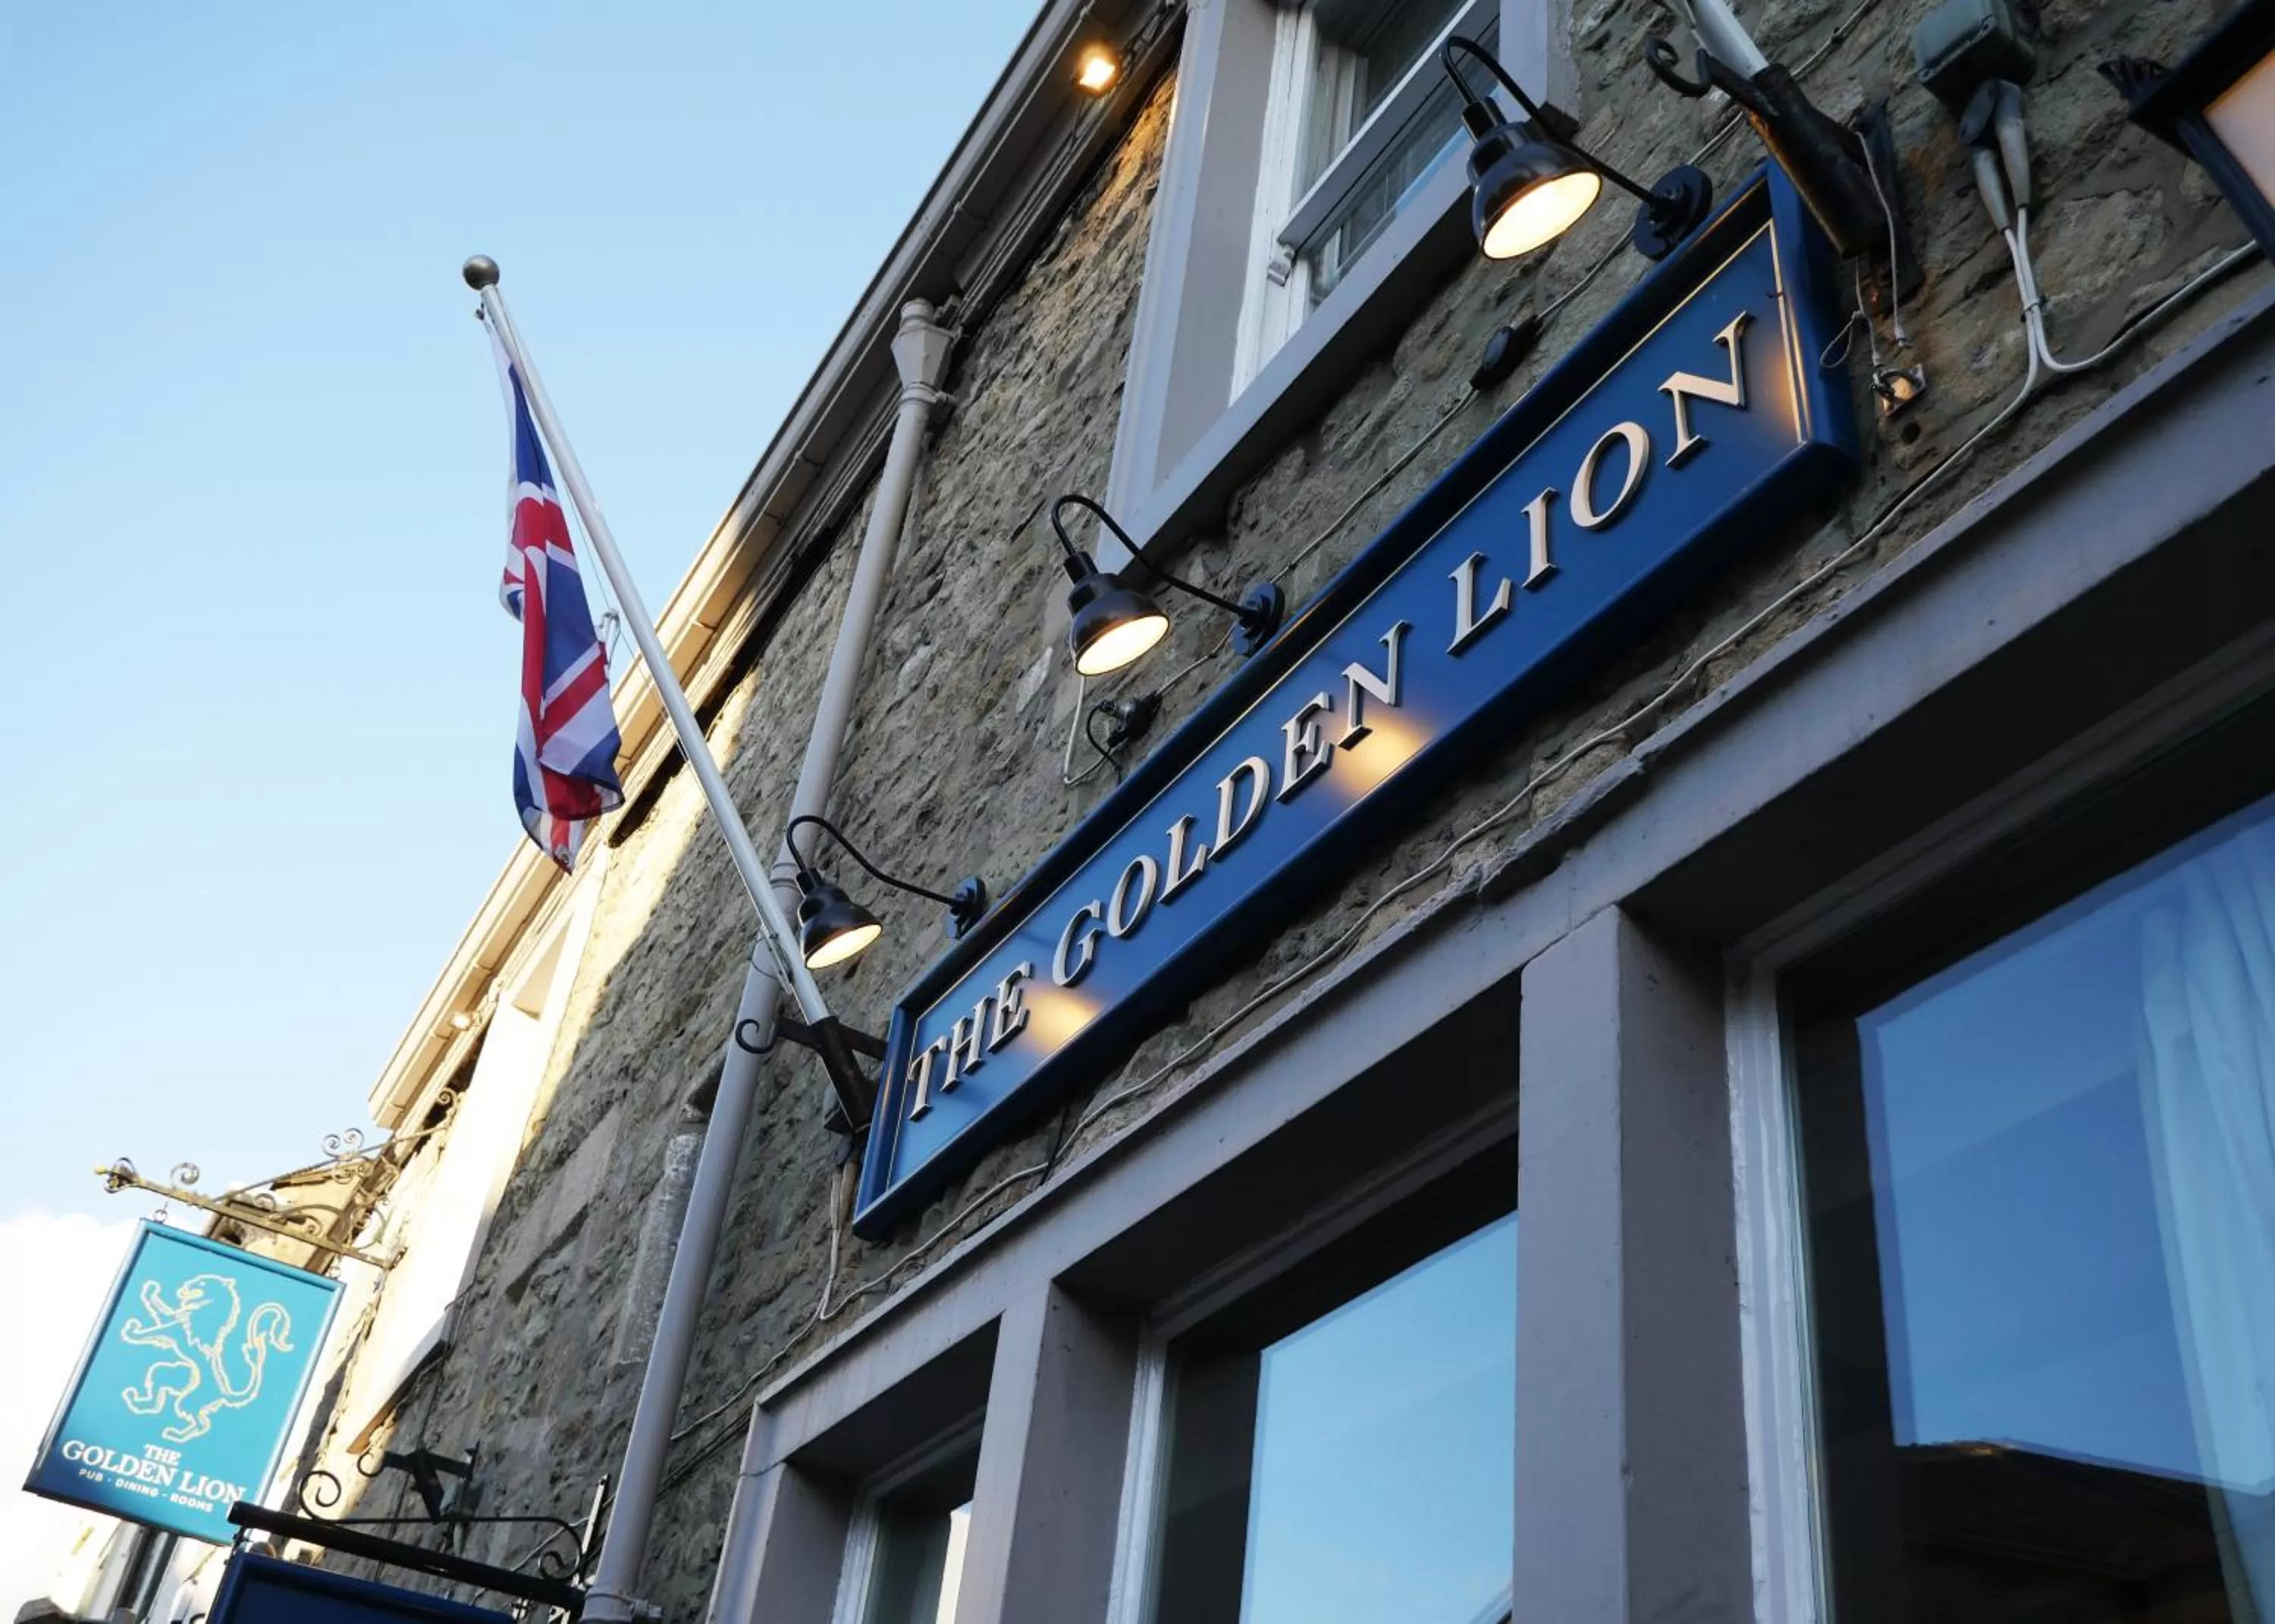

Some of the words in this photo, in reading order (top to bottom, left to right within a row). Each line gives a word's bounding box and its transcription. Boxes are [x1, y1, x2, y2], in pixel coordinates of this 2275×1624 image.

[908, 961, 1031, 1122] THE
[1052, 620, 1413, 987] GOLDEN
[1446, 309, 1756, 655] LION
[62, 1440, 179, 1487] GOLDEN
[178, 1472, 246, 1504] LION
[144, 1444, 182, 1466] THE
[79, 1468, 104, 1482] PUB
[115, 1478, 158, 1497] DINING
[169, 1494, 213, 1513] ROOMS
